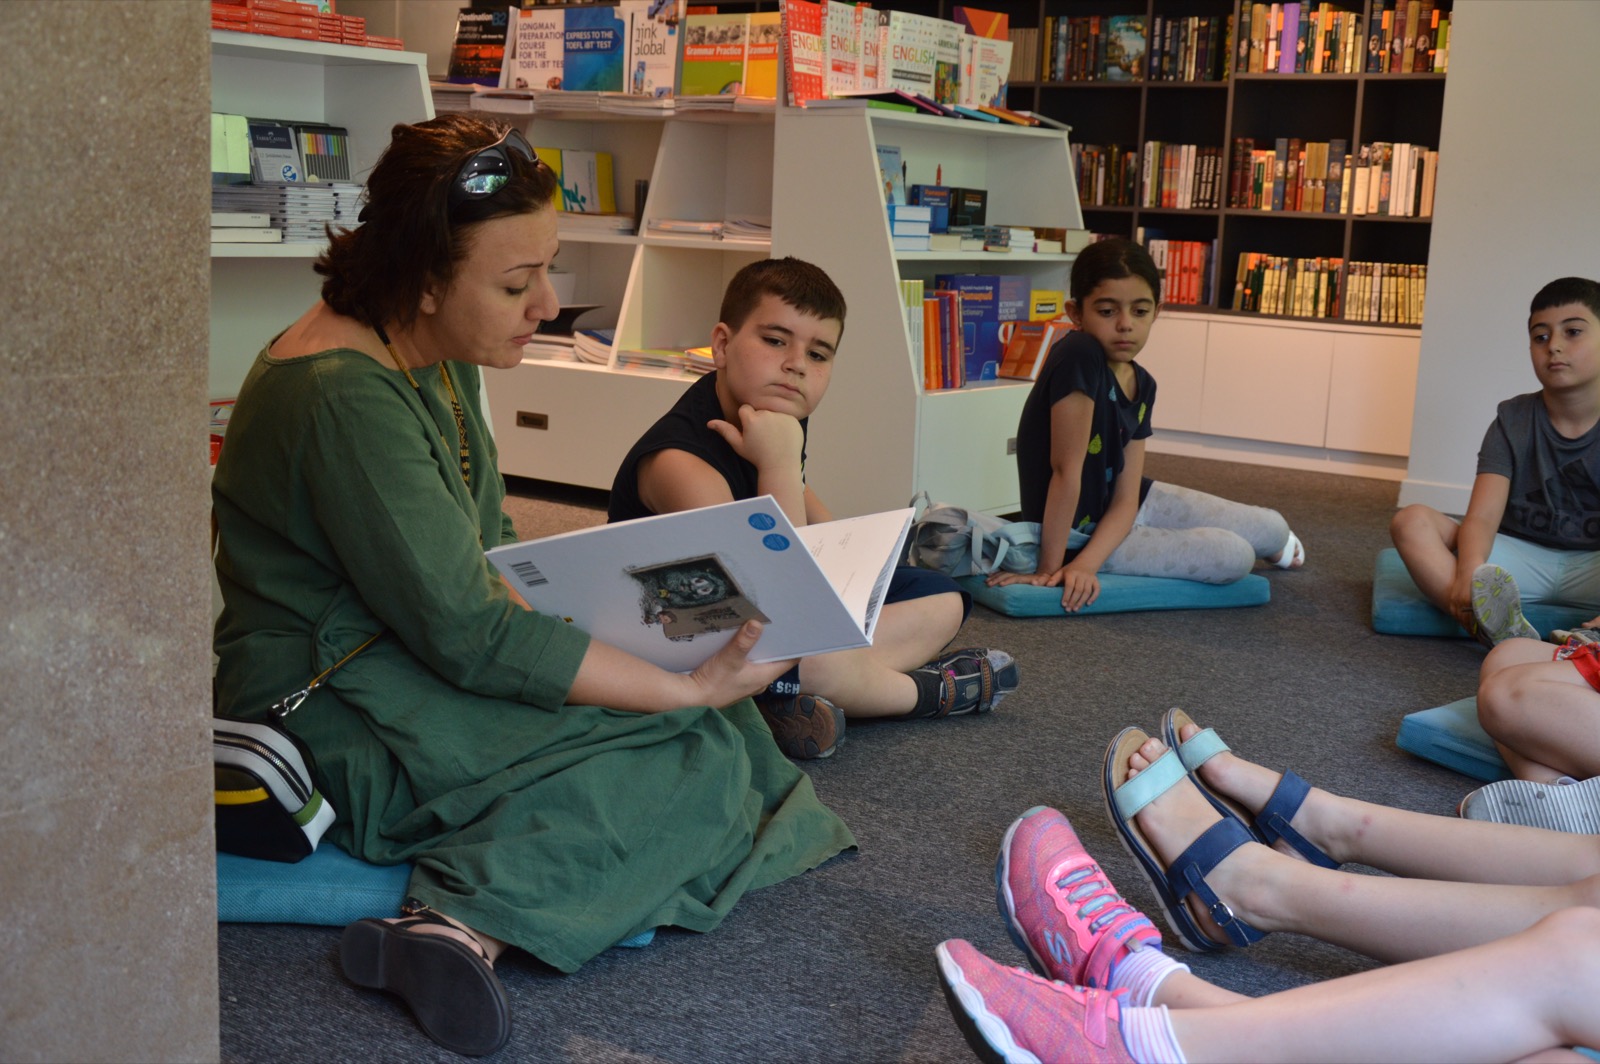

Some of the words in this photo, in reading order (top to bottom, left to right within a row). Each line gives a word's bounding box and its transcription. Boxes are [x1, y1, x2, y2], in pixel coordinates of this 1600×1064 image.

[459, 12, 493, 21] Destination
[492, 12, 507, 26] B2
[519, 22, 556, 31] LONGMAN
[565, 31, 591, 40] EXPRESS
[591, 31, 600, 39] TO
[601, 30, 614, 39] THE
[519, 41, 546, 50] COURSE
[565, 41, 583, 50] TOEFL
[596, 40, 612, 49] TEST
[791, 32, 821, 52] ENGLI
[831, 34, 856, 54] ENGLI
[519, 51, 532, 59] FOR
[534, 51, 547, 59] THE
[686, 46, 715, 56] Grammar
[716, 46, 742, 55] Practice
[892, 44, 935, 65] ENGLISH
[519, 60, 538, 69] TOEFL
[552, 60, 564, 68] TES
